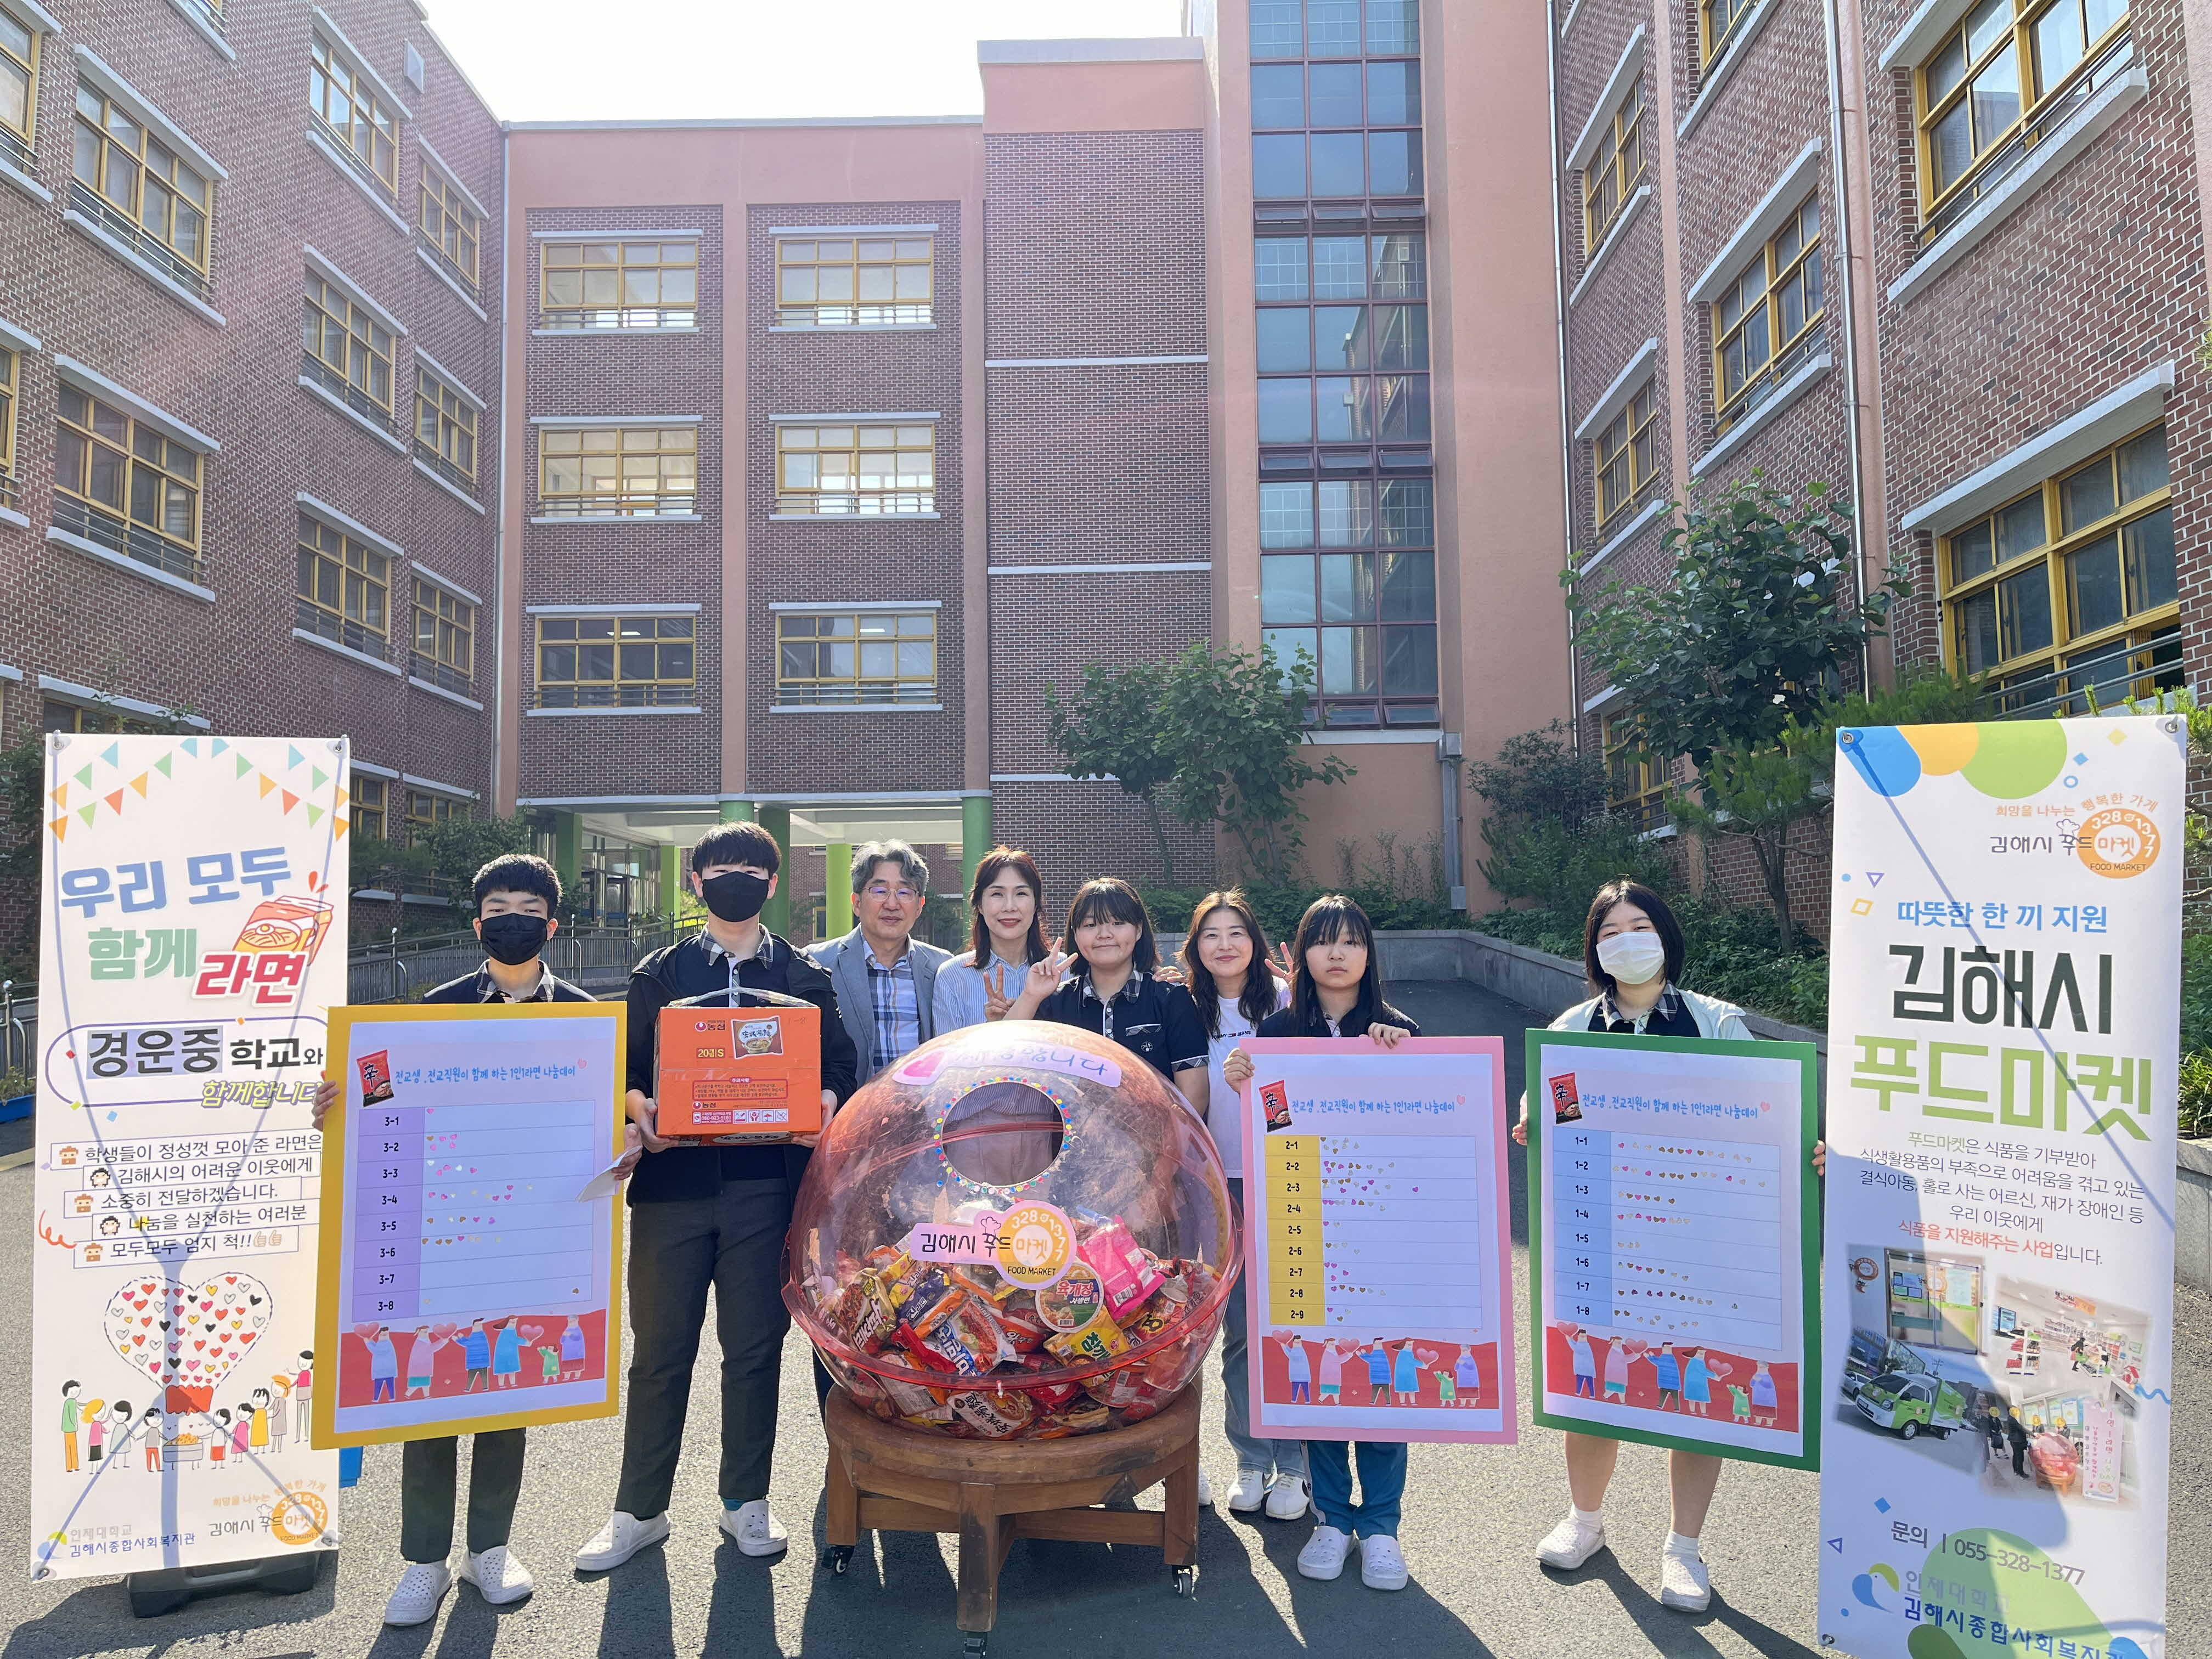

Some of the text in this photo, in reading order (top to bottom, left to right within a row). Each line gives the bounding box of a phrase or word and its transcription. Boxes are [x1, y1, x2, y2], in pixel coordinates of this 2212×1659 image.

[1996, 793, 2159, 817] 희망을 나누는 행복한 가게
[2092, 811, 2121, 829] 328
[2098, 837, 2134, 856] 마켓
[60, 847, 291, 919] 우리 모두
[1898, 900, 2107, 933] 따뜻한 한 끼 지원
[87, 927, 306, 1003] 함께 라면
[1889, 944, 2112, 1035] 김해시
[88, 1029, 323, 1077] 경운중 학교와
[364, 1063, 379, 1087] 辛
[395, 1070, 421, 1084] 전교생
[472, 1068, 488, 1082] 함께
[491, 1067, 507, 1081] 하는
[544, 1064, 575, 1079] 나눔데이
[1556, 1084, 1567, 1107] 辛
[1850, 1035, 2152, 1142] 푸드마켓
[1266, 1092, 1278, 1115] 辛
[1292, 1100, 1314, 1113] 전교생
[1358, 1100, 1373, 1113] 함께
[1376, 1100, 1391, 1113] 하는
[1424, 1099, 1454, 1114] 나눔데이
[1582, 1094, 1605, 1108] 전교생
[1653, 1099, 1669, 1113] 함께
[1672, 1100, 1688, 1115] 하는
[1724, 1104, 1758, 1119] 나눔데이
[384, 1117, 399, 1126] 3-1
[85, 1135, 322, 1164] 학생들이 정성껏 모아 준 라면은
[383, 1143, 399, 1152] 3-2
[1285, 1141, 1298, 1150] 2-1
[1575, 1137, 1588, 1146] 1-1
[1908, 1132, 2097, 1169] 푸드마켓은 식품을 기부받아
[118, 1156, 312, 1185] 김해시의 어려운 이웃에게
[382, 1169, 398, 1178] 3-3
[1286, 1163, 1299, 1171] 2-2
[1575, 1161, 1589, 1170] 1-2
[1860, 1148, 2145, 1200] 식생활용품의 부족으로 어려움을 겪고 있는
[101, 1183, 278, 1209] 소중히 전달하겠습니다.
[1286, 1183, 1300, 1192] 2-3
[1575, 1185, 1589, 1194] 1-3
[381, 1195, 398, 1205] 3-4
[1860, 1170, 2144, 1224] 결식아동, 홀로 사는 어르신, 재가 장애인 등
[1287, 1205, 1301, 1213] 2-4
[1575, 1209, 1589, 1219] 1-4
[128, 1205, 307, 1232] 나눔을 실천하는 여러분
[381, 1222, 397, 1231] 3-5
[1012, 1210, 1037, 1228] 328
[1949, 1205, 2043, 1233] 우리 이웃에게
[1288, 1226, 1301, 1234] 2-5
[1576, 1233, 1589, 1243] 1-5
[1898, 1220, 1942, 1240] 식품을
[1944, 1226, 2019, 1254] 지원해주는
[110, 1240, 178, 1257] 모두모두
[185, 1235, 216, 1253] 엄지
[380, 1248, 396, 1257] 3-6
[1016, 1238, 1048, 1260] 마켓
[1289, 1247, 1302, 1255] 2-6
[1576, 1257, 1589, 1267] 1-6
[379, 1274, 395, 1284] 3-7
[1007, 1266, 1056, 1276] FOOD MARKET
[1289, 1268, 1302, 1277] 2-7
[1056, 1280, 1094, 1296] 육개장
[1290, 1289, 1304, 1298] 2-8
[1576, 1282, 1589, 1291] 1-7
[378, 1301, 394, 1311] 3-8
[1290, 1310, 1304, 1319] 2-9
[1576, 1306, 1590, 1315] 1-8
[70, 1532, 195, 1557] 김해시종합사회복지관
[1891, 1520, 2085, 1586] 문의 055-328-1377
